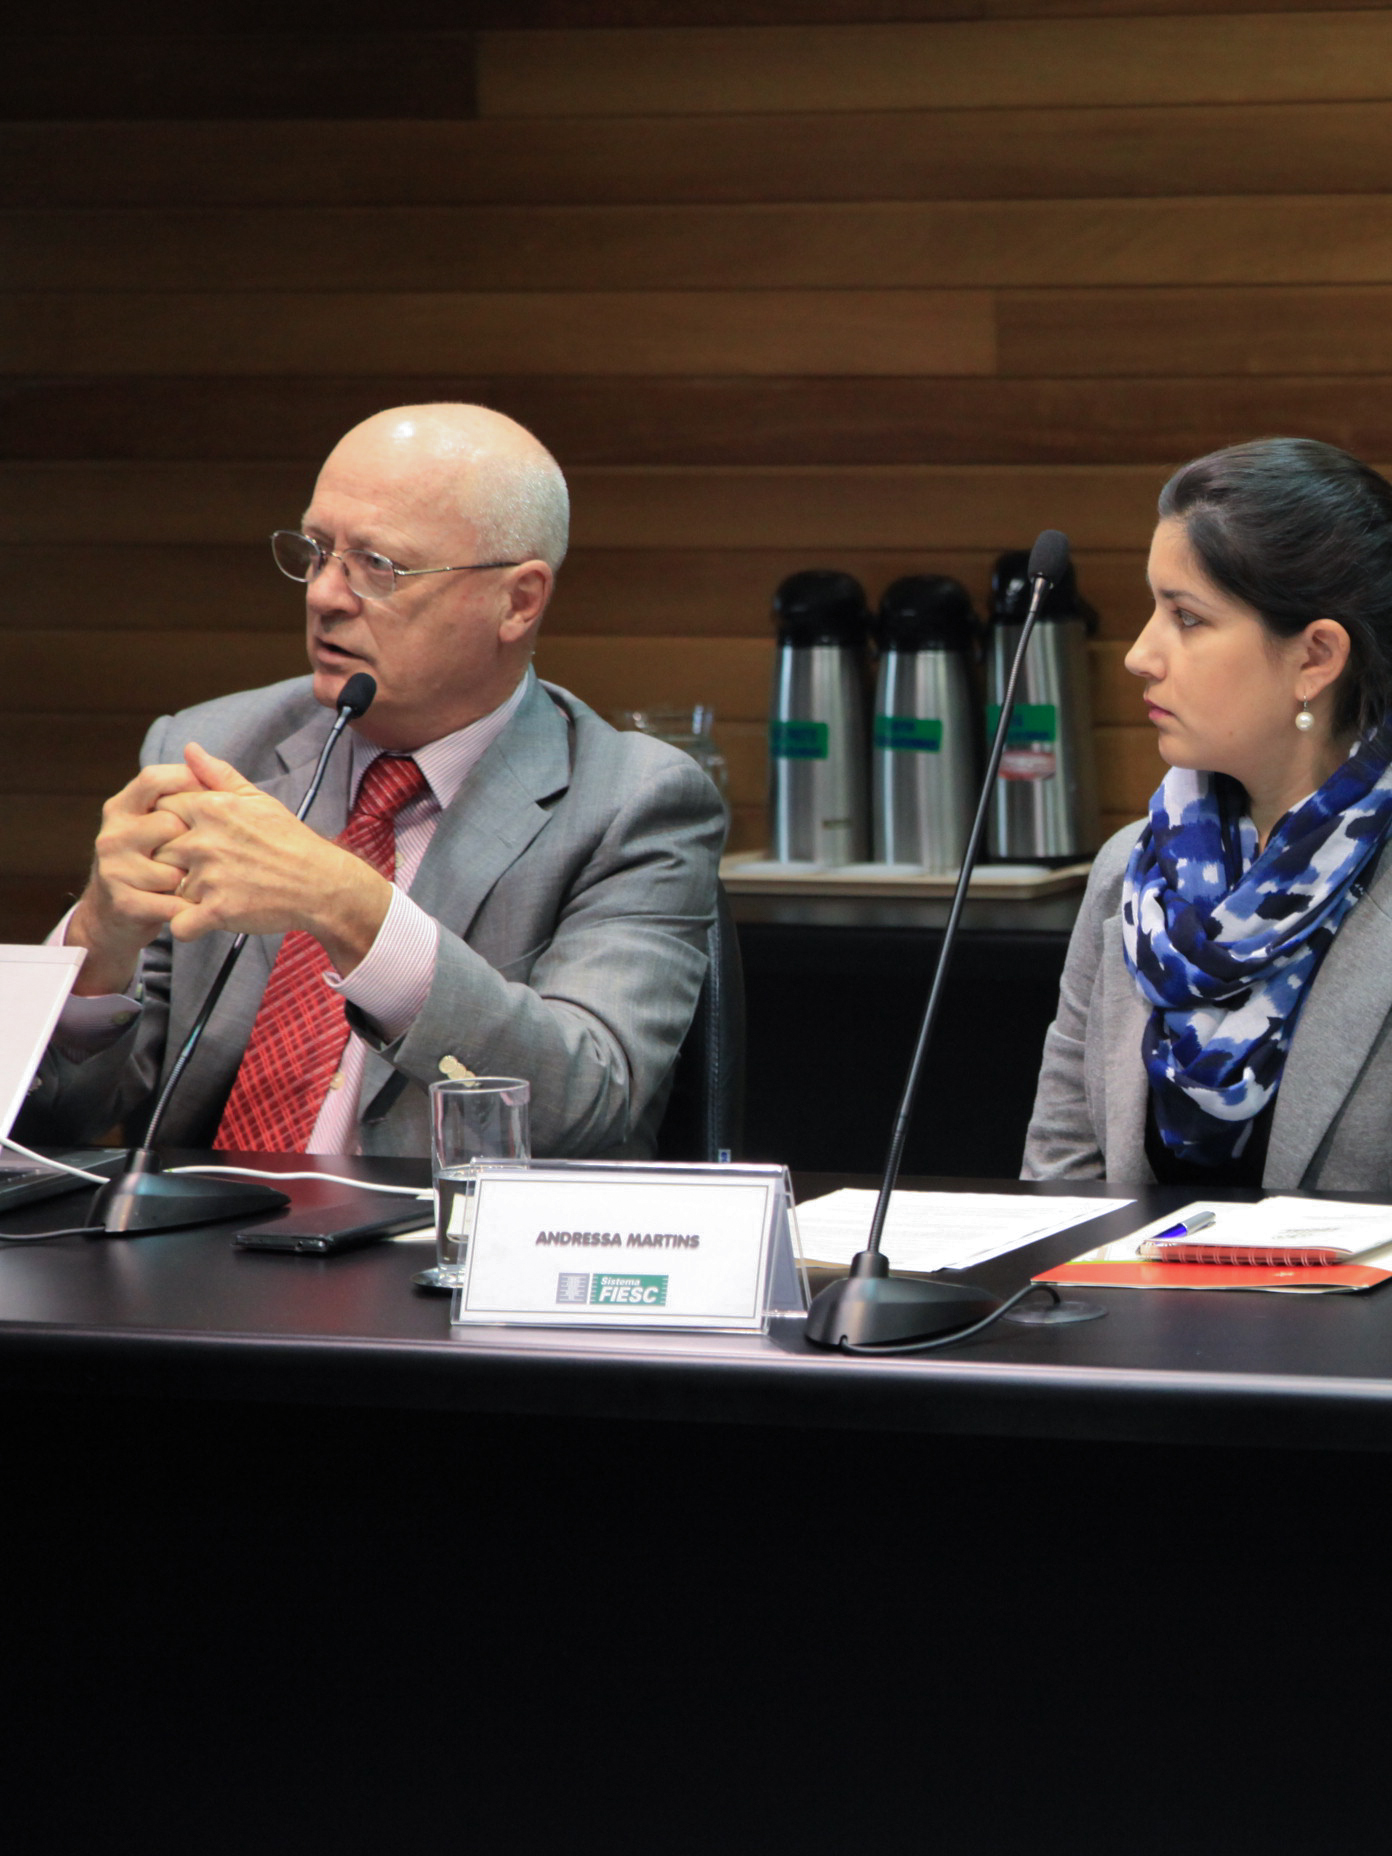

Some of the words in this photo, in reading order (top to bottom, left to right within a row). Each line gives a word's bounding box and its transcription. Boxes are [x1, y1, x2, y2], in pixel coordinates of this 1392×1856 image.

[536, 1231, 622, 1247] ANDRESSA
[627, 1233, 700, 1249] MARTINS
[600, 1276, 641, 1286] Sistema
[599, 1286, 658, 1304] FIESC
